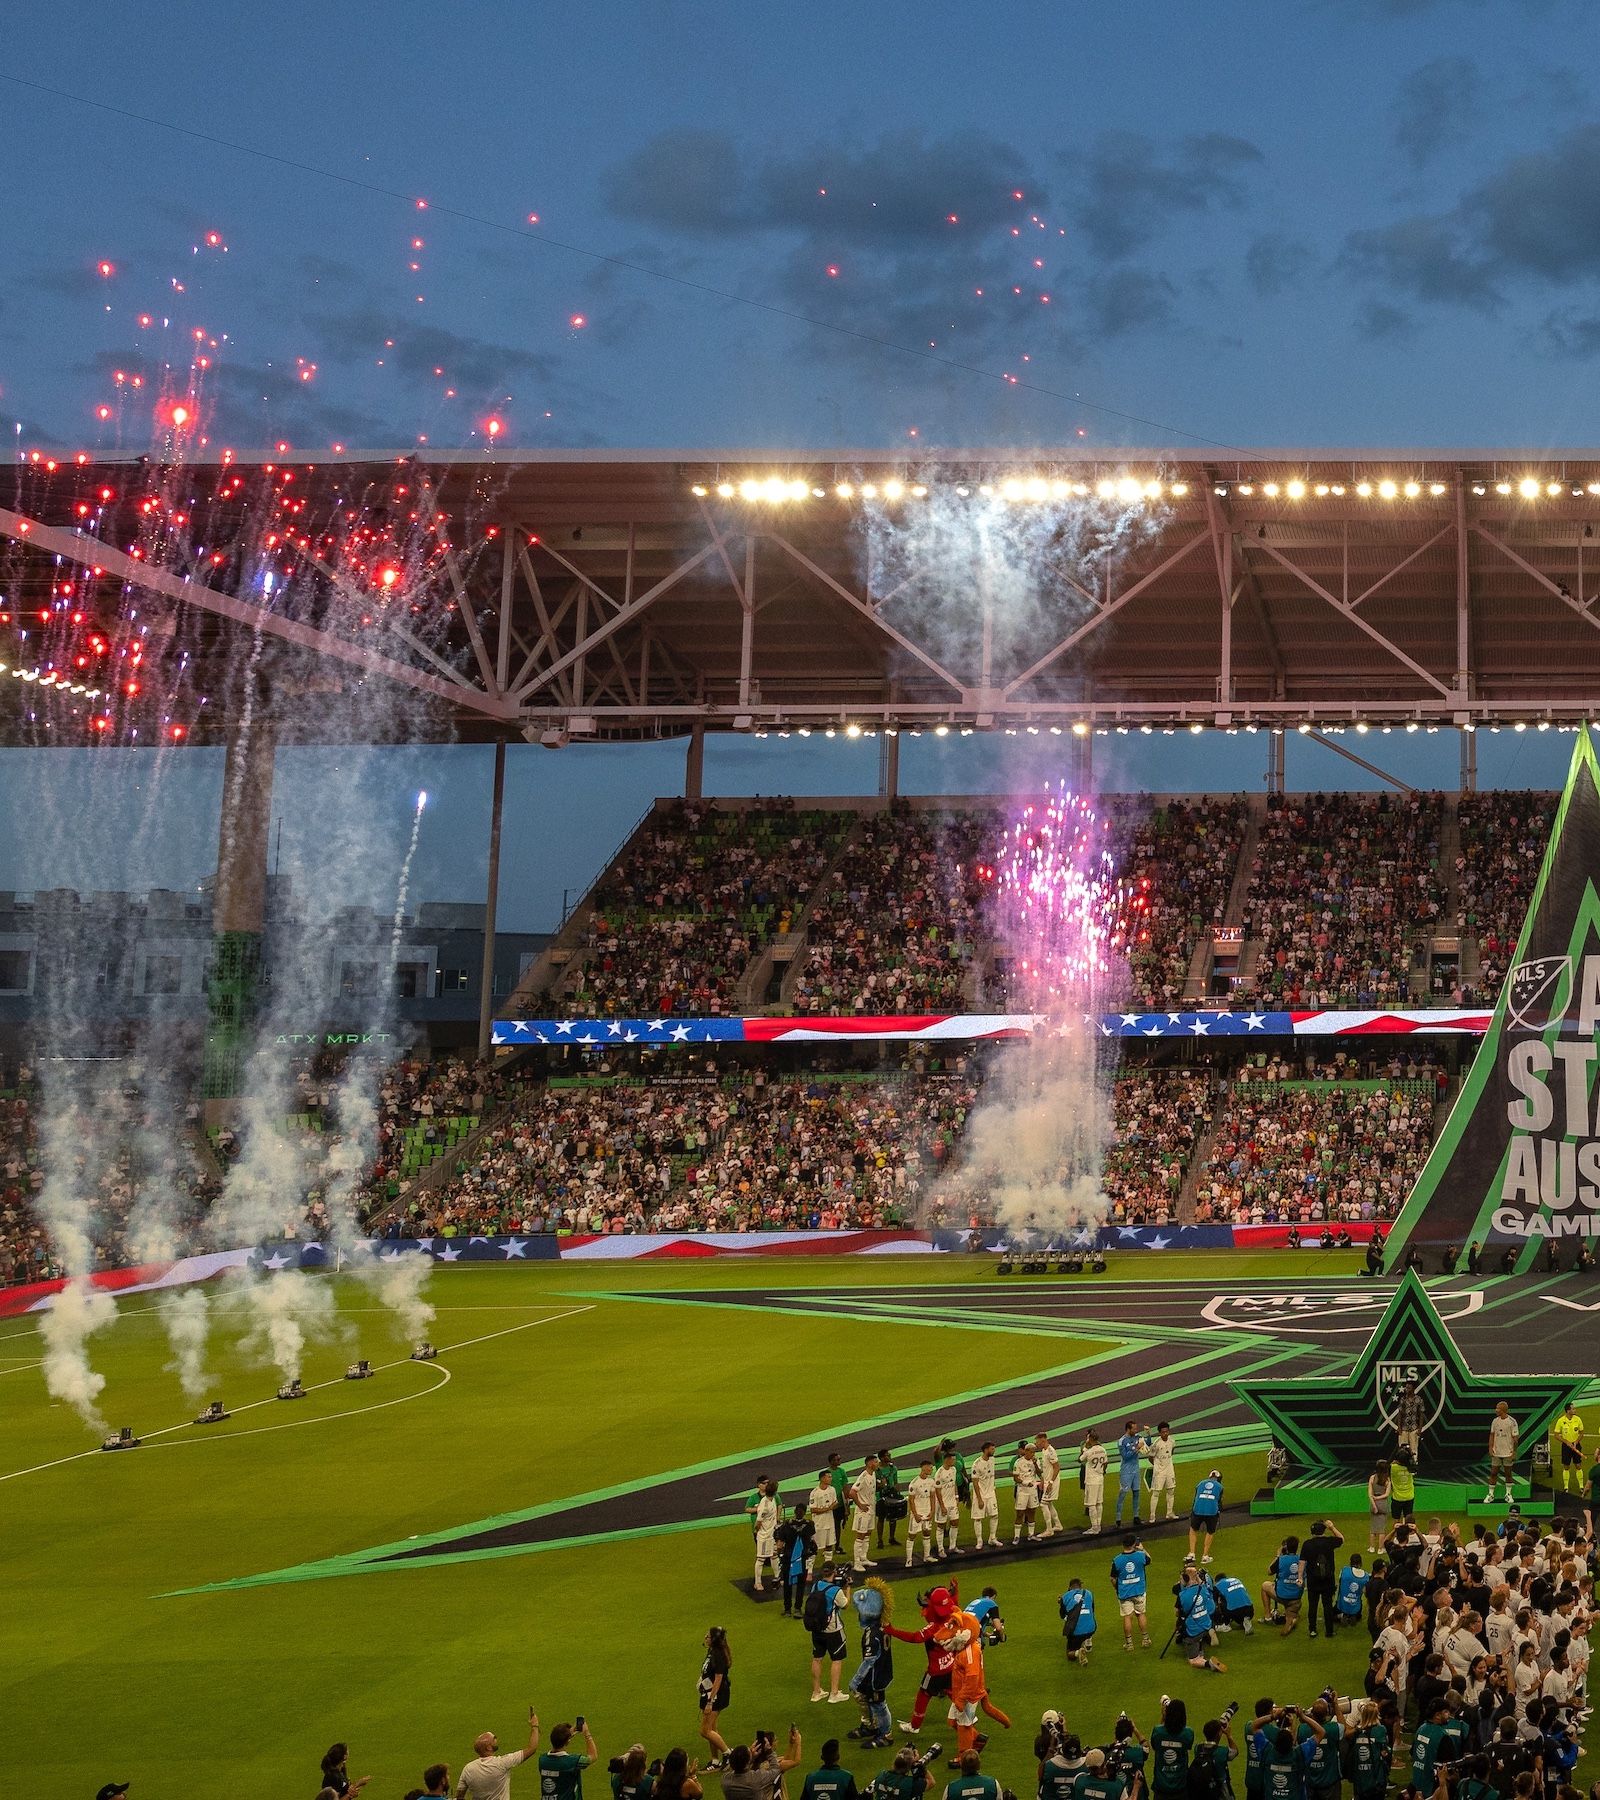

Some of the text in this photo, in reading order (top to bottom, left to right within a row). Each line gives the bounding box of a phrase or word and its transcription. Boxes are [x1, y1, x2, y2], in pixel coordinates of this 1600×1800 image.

[1512, 964, 1546, 985] MLS
[276, 1033, 390, 1043] ATX MRKT
[1231, 1296, 1373, 1306] MLS
[1382, 1367, 1419, 1382] MLS
[1489, 1627, 1499, 1638] 25
[1447, 1638, 1455, 1650] 25
